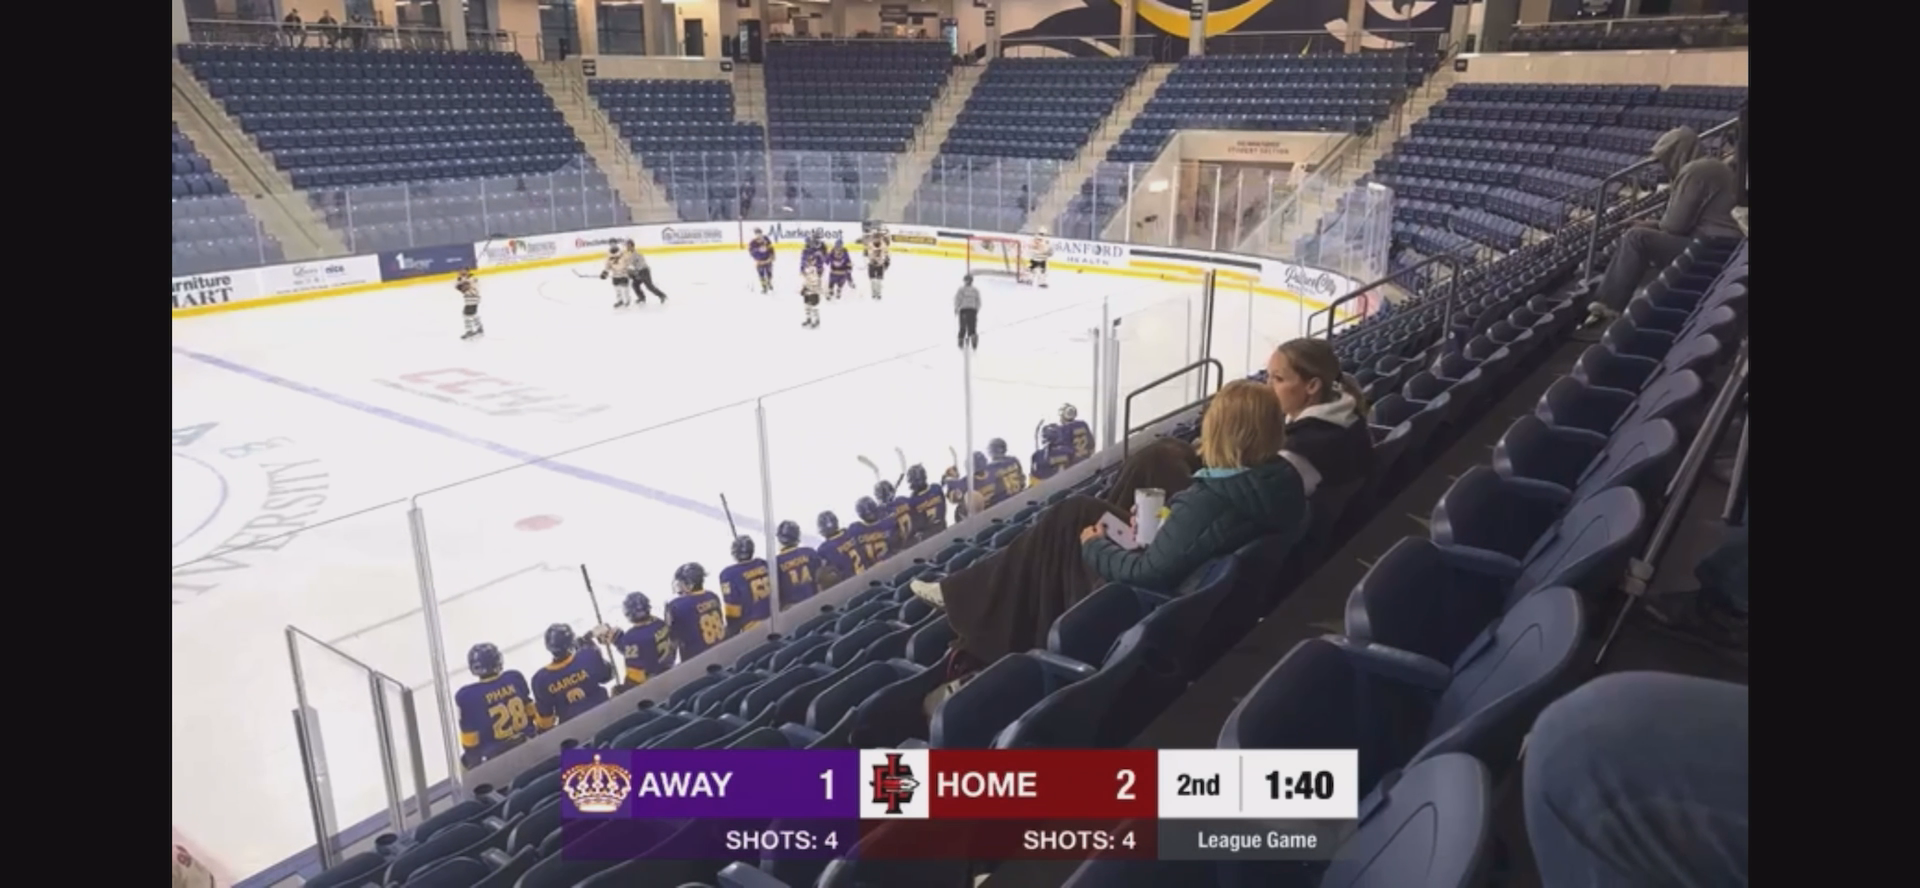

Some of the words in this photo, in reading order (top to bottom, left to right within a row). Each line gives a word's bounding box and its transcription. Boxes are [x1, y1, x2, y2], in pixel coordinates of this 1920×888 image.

[1055, 241, 1124, 258] SANFORD
[548, 670, 590, 694] GARCIA
[485, 684, 517, 704] PHAN
[488, 696, 529, 739] 28
